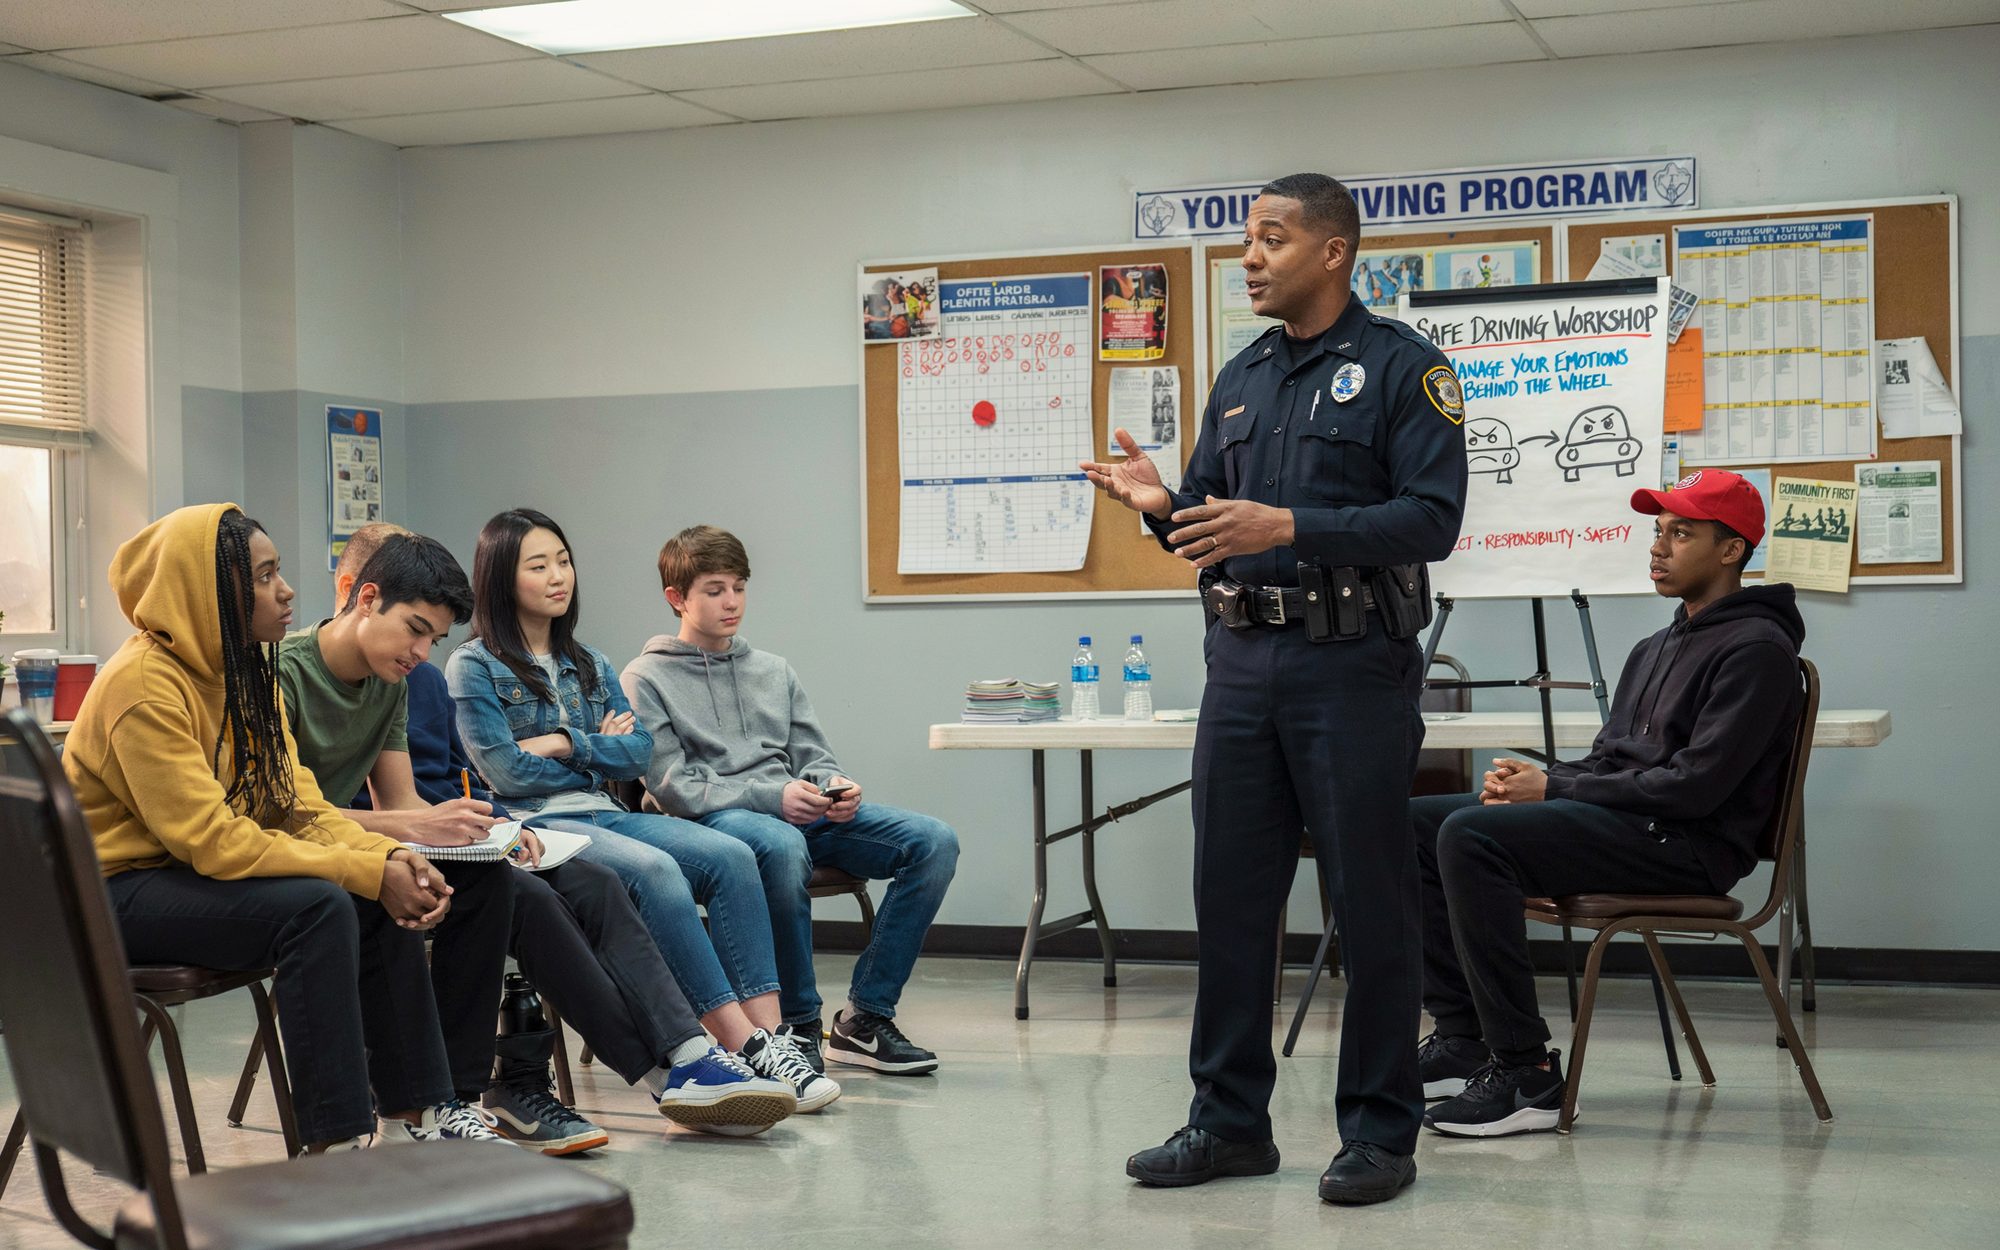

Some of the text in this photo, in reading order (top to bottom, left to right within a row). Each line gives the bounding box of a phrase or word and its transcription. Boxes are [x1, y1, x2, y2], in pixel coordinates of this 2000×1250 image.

[1181, 194, 1260, 229] YOU
[1460, 169, 1648, 213] PROGRAM
[1417, 304, 1658, 346] SAFE DRIVING WORKSHOP
[1511, 352, 1550, 379] YOUR
[1554, 348, 1629, 374] EMOTIONS
[1463, 372, 1612, 401] BEHIND THE WHEEL
[1779, 482, 1831, 499] COMMUNITY
[1831, 487, 1856, 500] FIRST
[1485, 528, 1574, 550] RESPONSIBILITY
[1583, 525, 1632, 543] SAFETY
